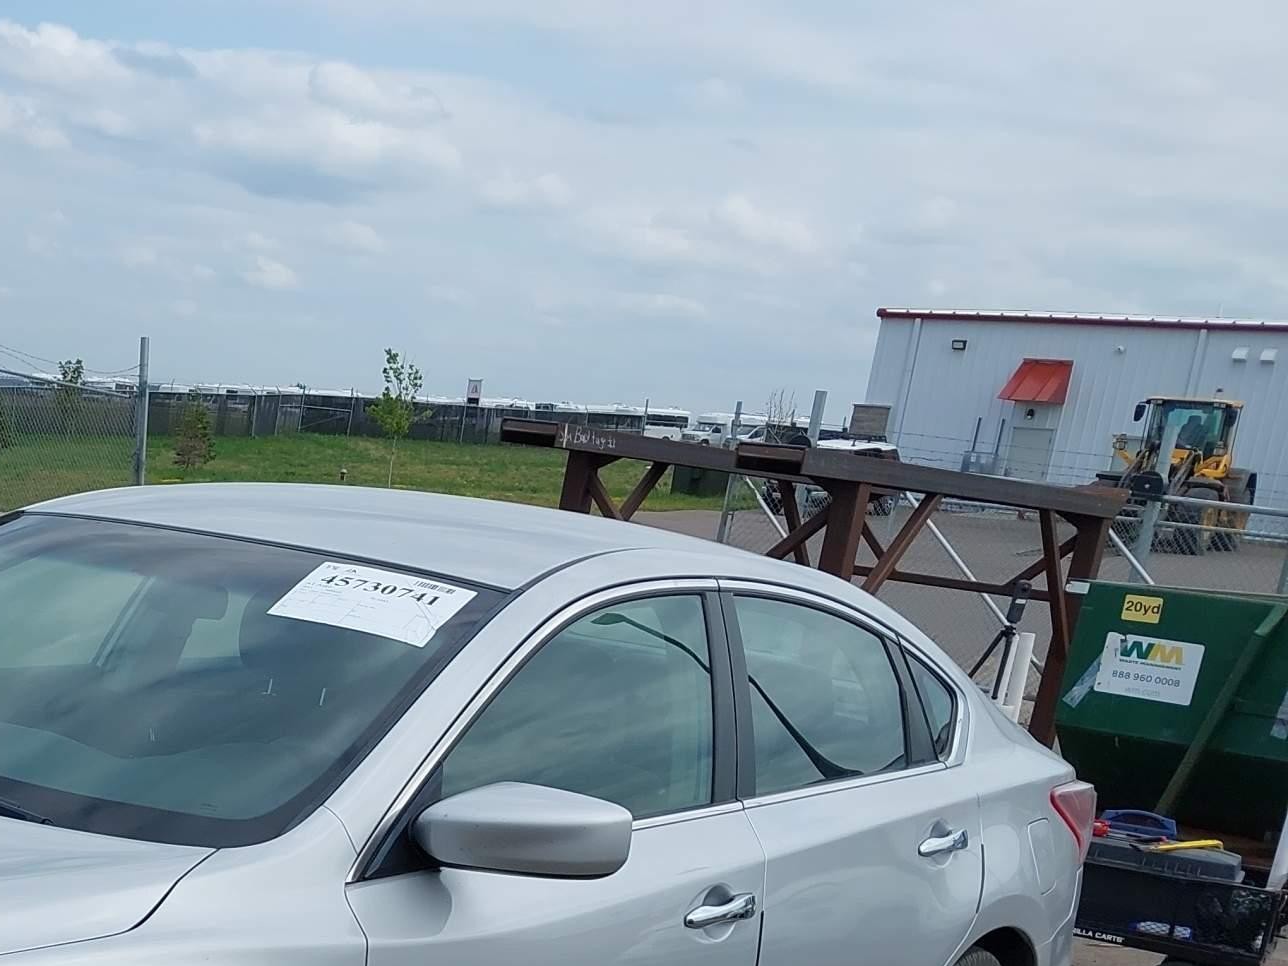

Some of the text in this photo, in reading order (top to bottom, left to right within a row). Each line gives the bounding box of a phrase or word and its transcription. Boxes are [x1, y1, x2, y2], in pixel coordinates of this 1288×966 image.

[320, 575, 441, 606] 45730741
[1124, 600, 1161, 616] 20yd
[1120, 639, 1184, 666] WM
[1112, 669, 1181, 688] 888 960 0008
